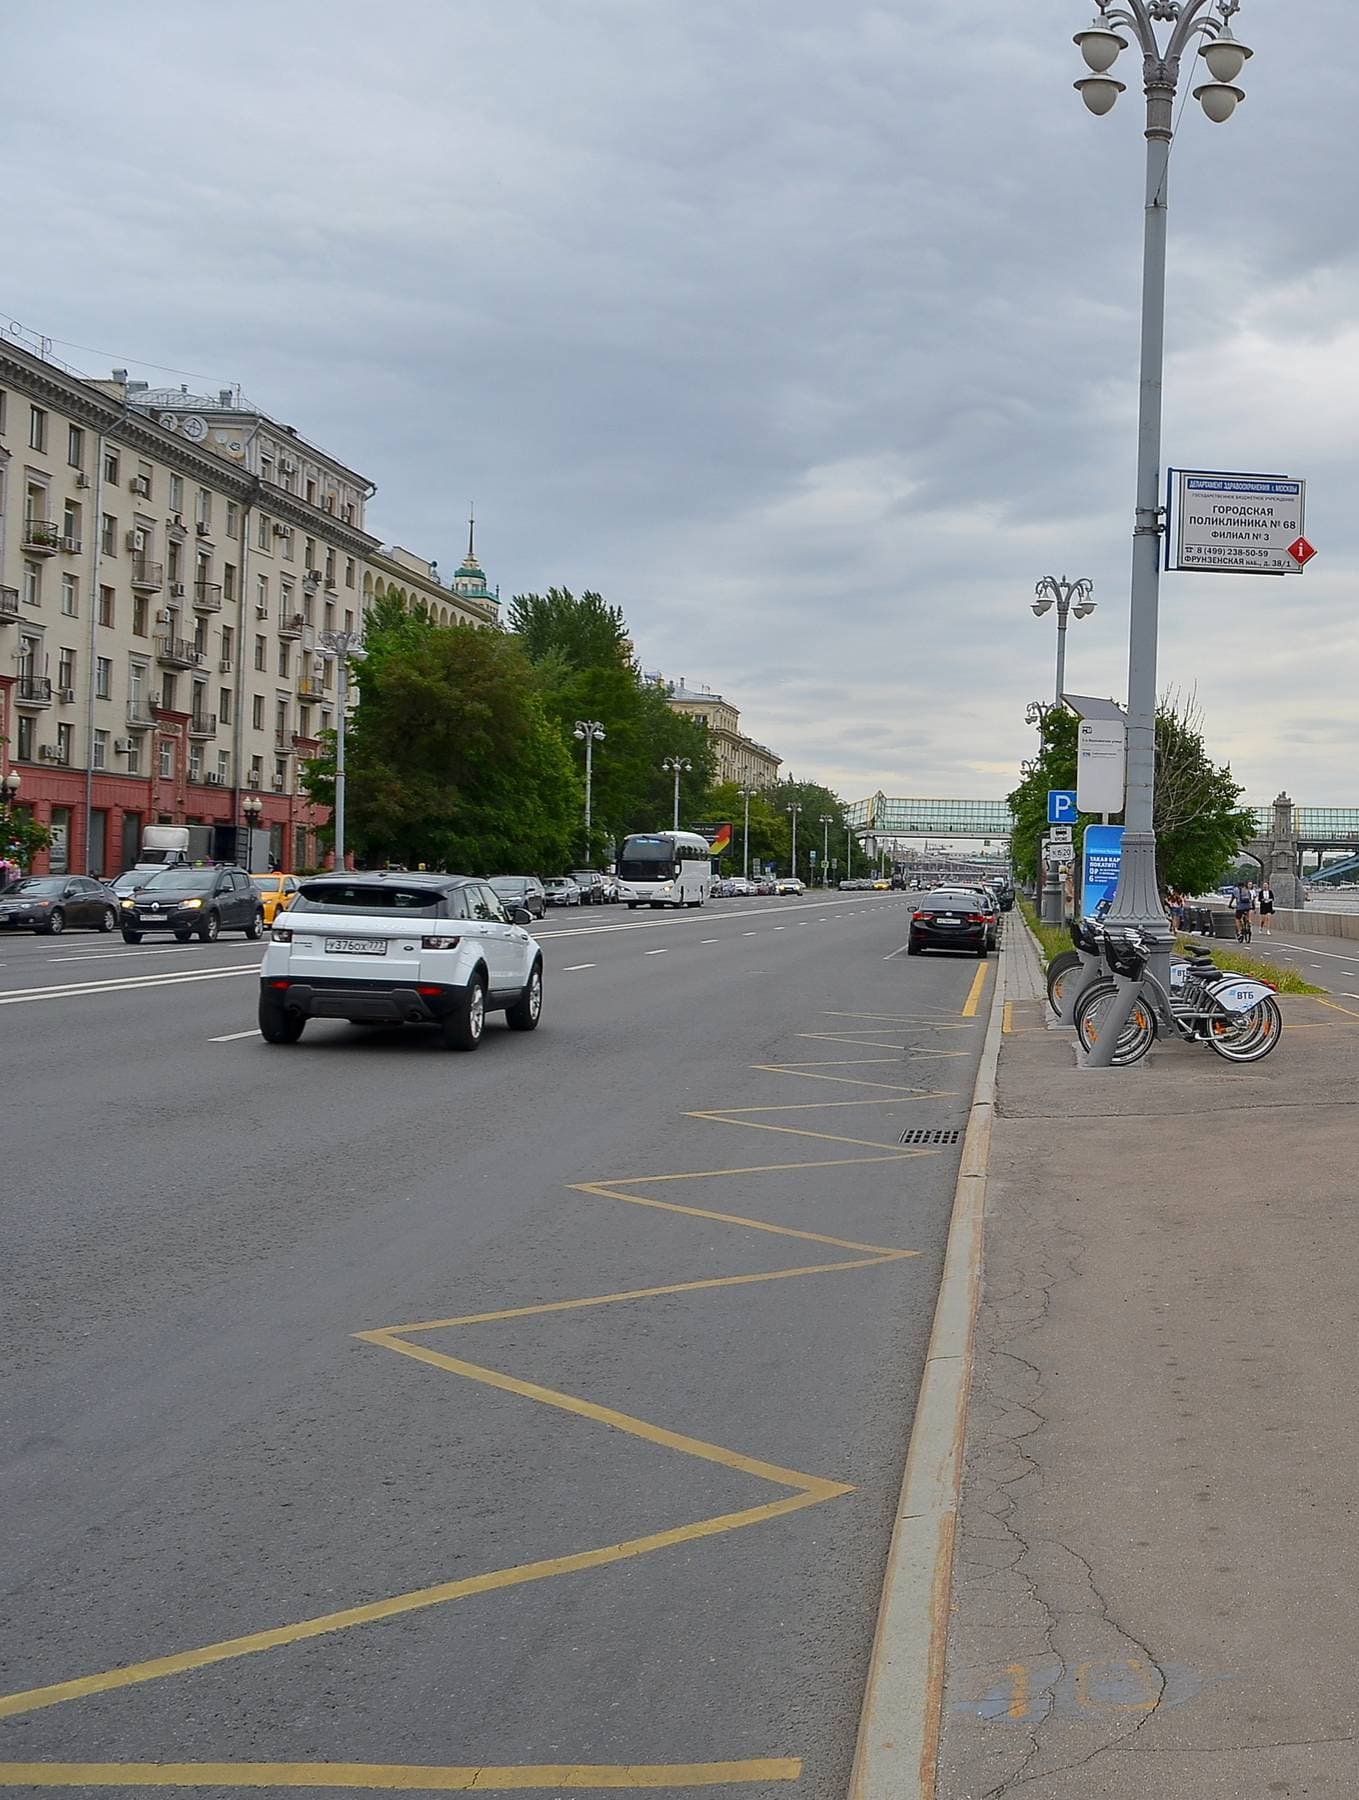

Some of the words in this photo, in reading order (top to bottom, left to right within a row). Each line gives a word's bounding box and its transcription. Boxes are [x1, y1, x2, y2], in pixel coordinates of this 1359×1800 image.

[1212, 505, 1274, 516] ГОРОДСКАЯ
[1189, 516, 1268, 528] ПОЛИКЛИНИКА
[1283, 520, 1296, 529] 68
[1211, 531, 1250, 541] ФИЛИАЛ
[1263, 532, 1270, 541] 3
[1204, 547, 1226, 556] (499)
[1227, 548, 1269, 557] 238-50-59
[1184, 555, 1245, 566] ФРУНЗЕНСКАЯ
[1272, 560, 1291, 568] 38/1
[1055, 794, 1071, 819] P
[1236, 991, 1254, 1000] ВТБ
